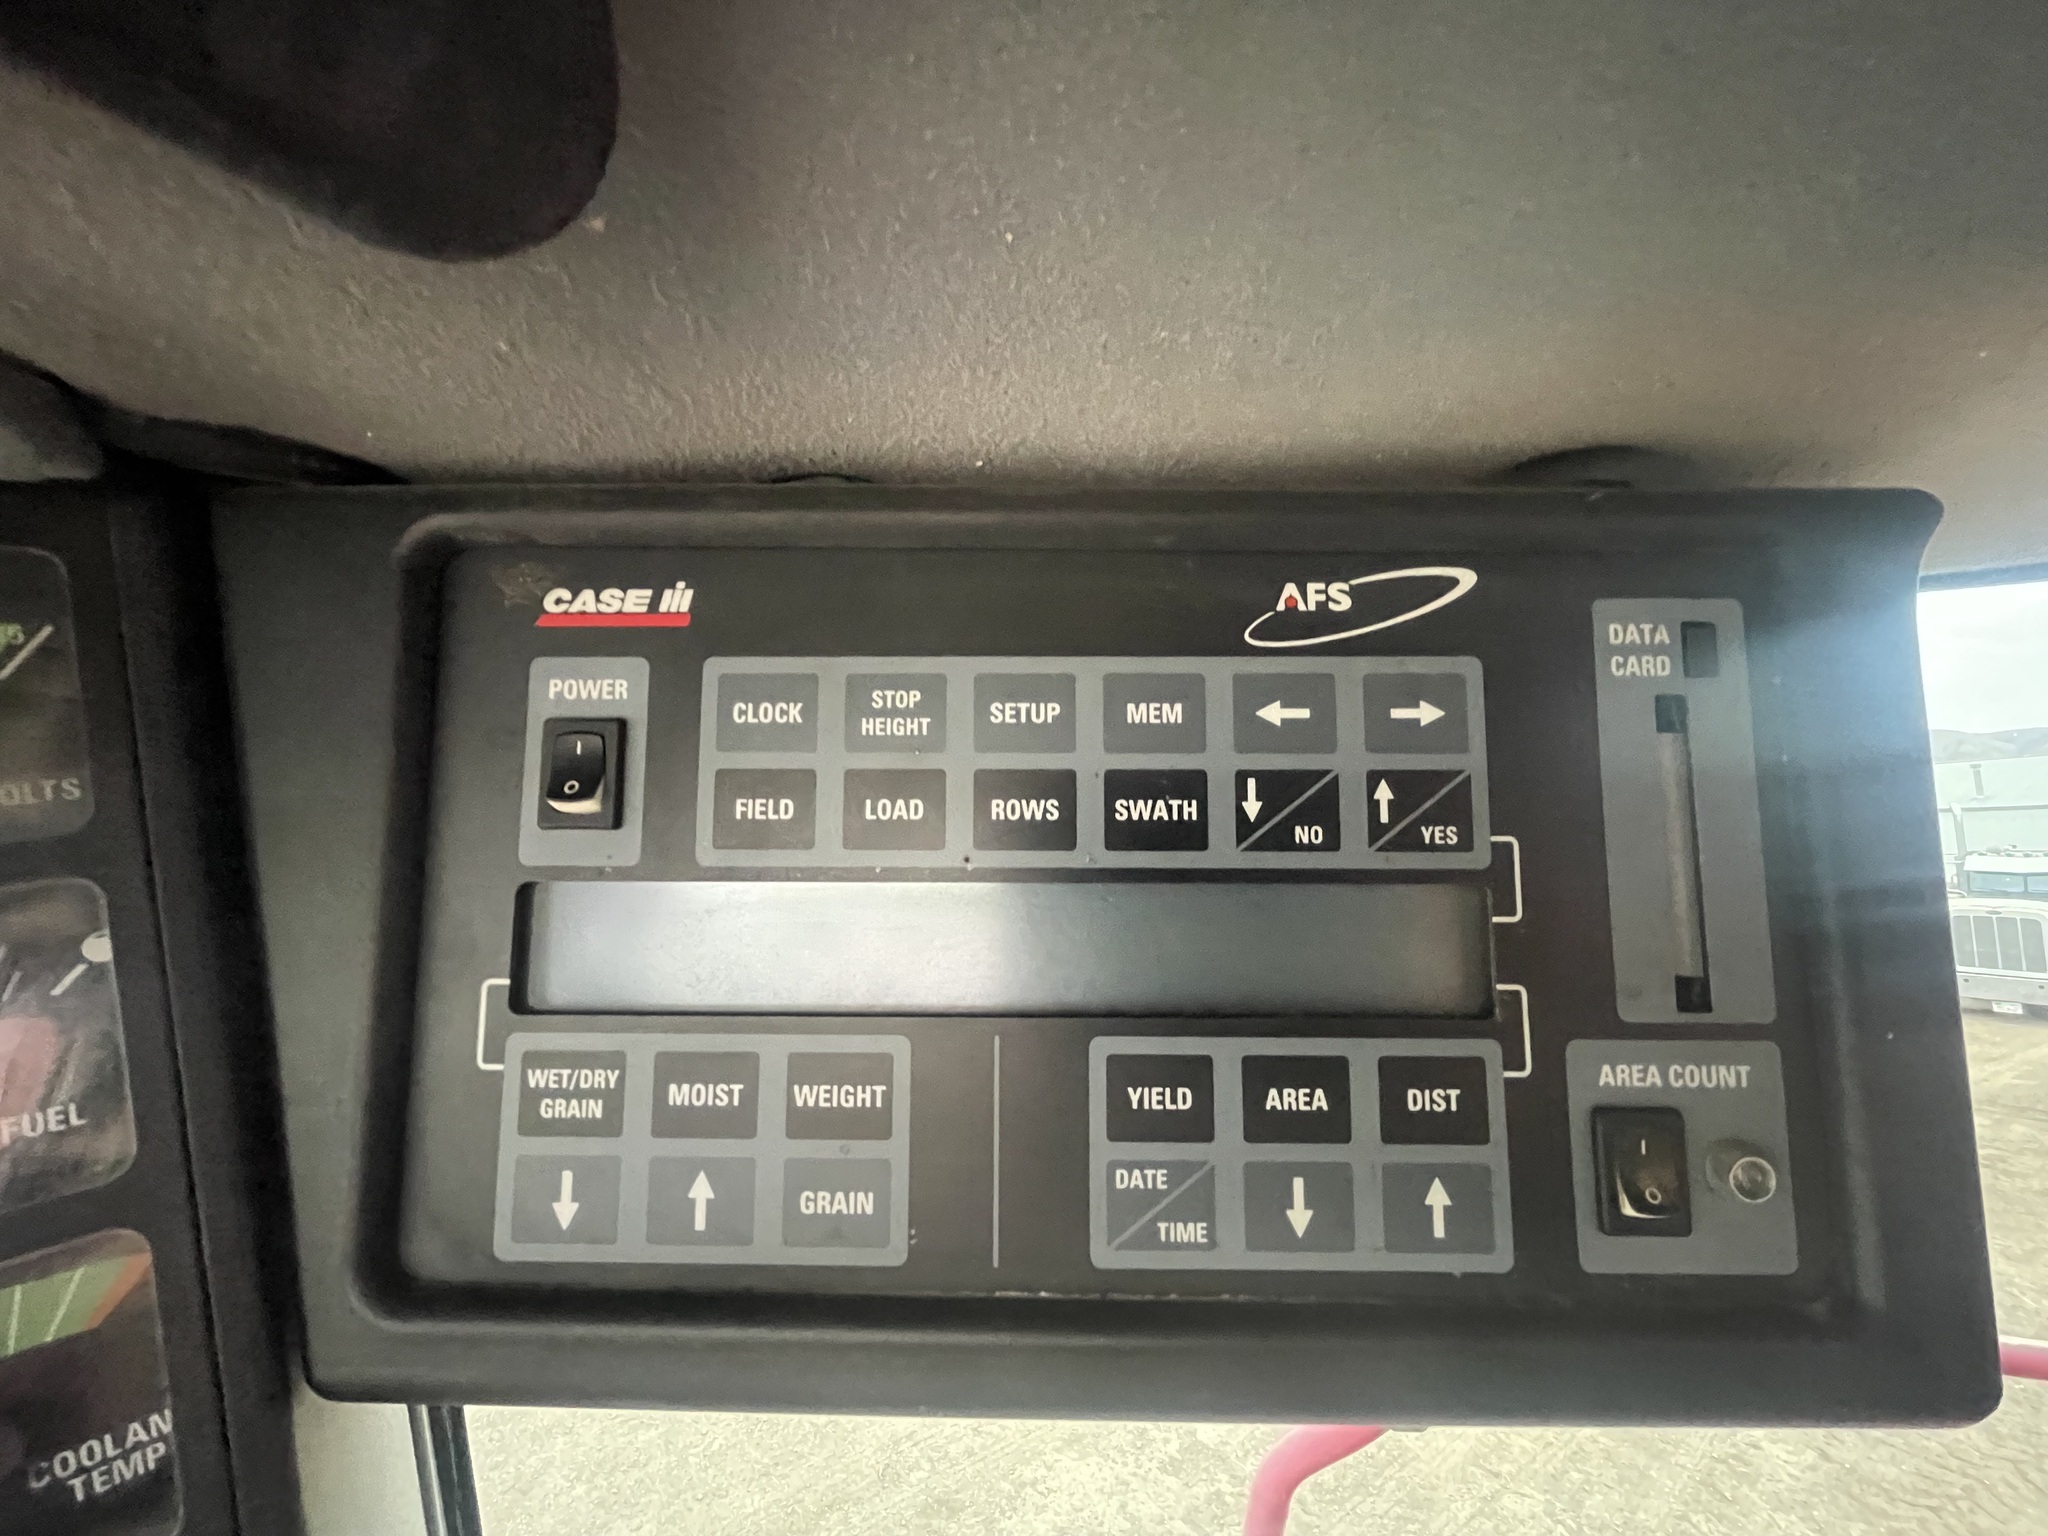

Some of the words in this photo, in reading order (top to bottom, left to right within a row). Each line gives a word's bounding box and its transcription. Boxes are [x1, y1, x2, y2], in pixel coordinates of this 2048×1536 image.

[542, 587, 652, 613] CASE
[1275, 581, 1353, 612] AFS
[1608, 622, 1671, 646] DATA
[1610, 655, 1671, 677] CARD
[548, 678, 628, 700] POWER
[871, 689, 922, 709] STOP
[732, 701, 803, 724] CLOCK
[989, 701, 1061, 724] SETUP
[1126, 702, 1183, 724] MEM
[861, 717, 931, 737] HEIGHT
[735, 798, 795, 820] FIELD
[864, 798, 924, 821] LOAD
[990, 798, 1060, 821] ROWS
[1114, 798, 1198, 821] SWATH
[1294, 825, 1323, 845] NO
[1420, 825, 1458, 845] YES
[527, 1068, 620, 1091] WET/DRY
[1598, 1064, 1662, 1088] AREA
[1668, 1064, 1751, 1089] COUNT
[668, 1083, 744, 1107] MOIST
[793, 1084, 887, 1108] WEIGHT
[1127, 1086, 1193, 1110] YIELD
[1265, 1087, 1329, 1111] AREA
[1407, 1088, 1461, 1112] DIST
[539, 1098, 603, 1119] GRAIN
[0, 1102, 88, 1146] FUEL
[1115, 1168, 1168, 1190] DATE
[799, 1190, 874, 1215] GRAIN
[1156, 1221, 1208, 1243] TIME
[66, 1441, 167, 1502] TEMP
